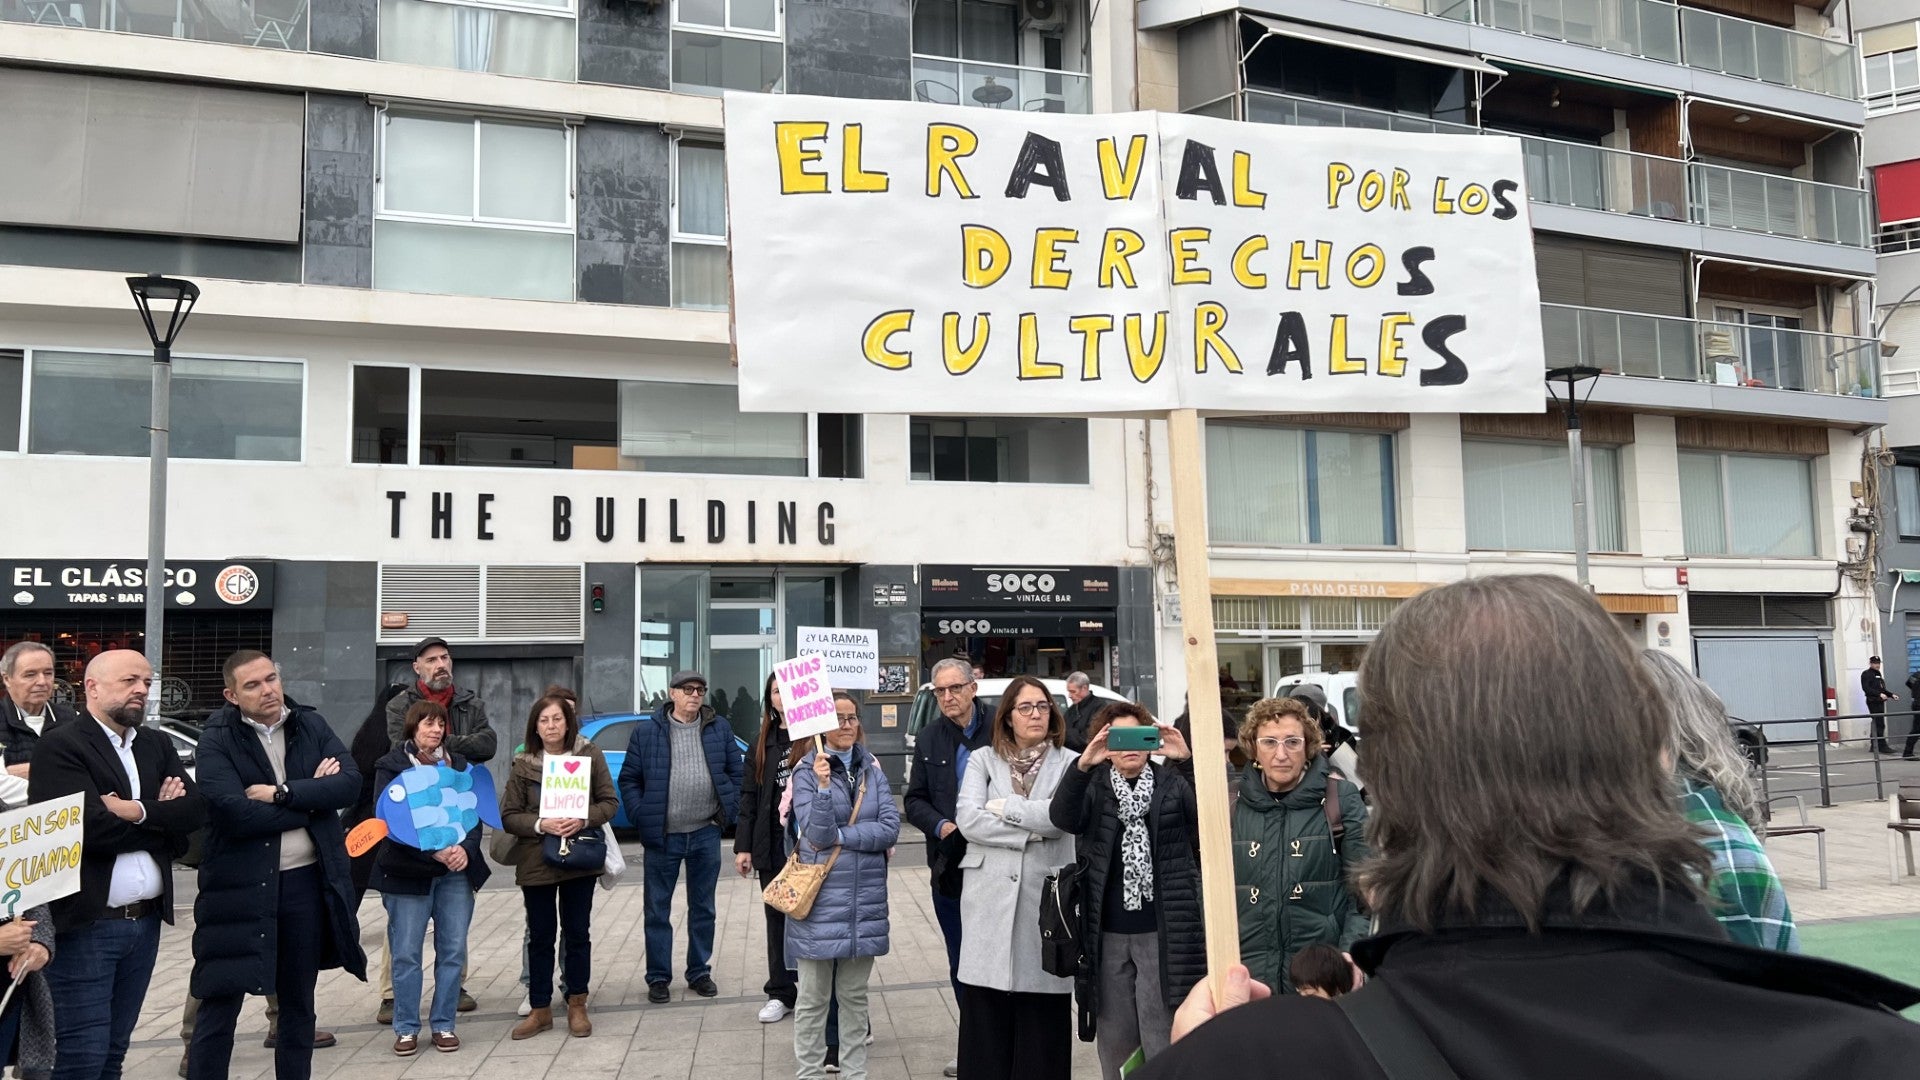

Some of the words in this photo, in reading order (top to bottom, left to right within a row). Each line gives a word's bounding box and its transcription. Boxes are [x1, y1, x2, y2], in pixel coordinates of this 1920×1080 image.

[774, 121, 889, 195] EL
[926, 122, 1267, 208] RAVAL
[1326, 162, 1412, 211] POR
[1434, 176, 1520, 221] LOS
[961, 223, 1436, 297] DERECHOS
[862, 301, 1469, 387] CULTURALES
[386, 491, 495, 540] THE
[553, 495, 835, 545] BUILDING
[13, 567, 52, 587] EL
[987, 574, 1055, 592] SOCO
[67, 593, 107, 603] TAPAS
[118, 593, 144, 603] BAR
[1290, 583, 1387, 596] PANADERIA
[938, 619, 991, 635] SOCO
[805, 634, 816, 643] ¿Y
[819, 634, 829, 643] LA
[831, 634, 870, 645] RAMPA
[800, 648, 827, 658] C/SN
[830, 650, 875, 660] CAYETANO
[778, 658, 820, 682] VIVAS
[550, 761, 555, 773] I
[545, 776, 588, 791] RAVAL
[5, 841, 81, 889] CUANDO
